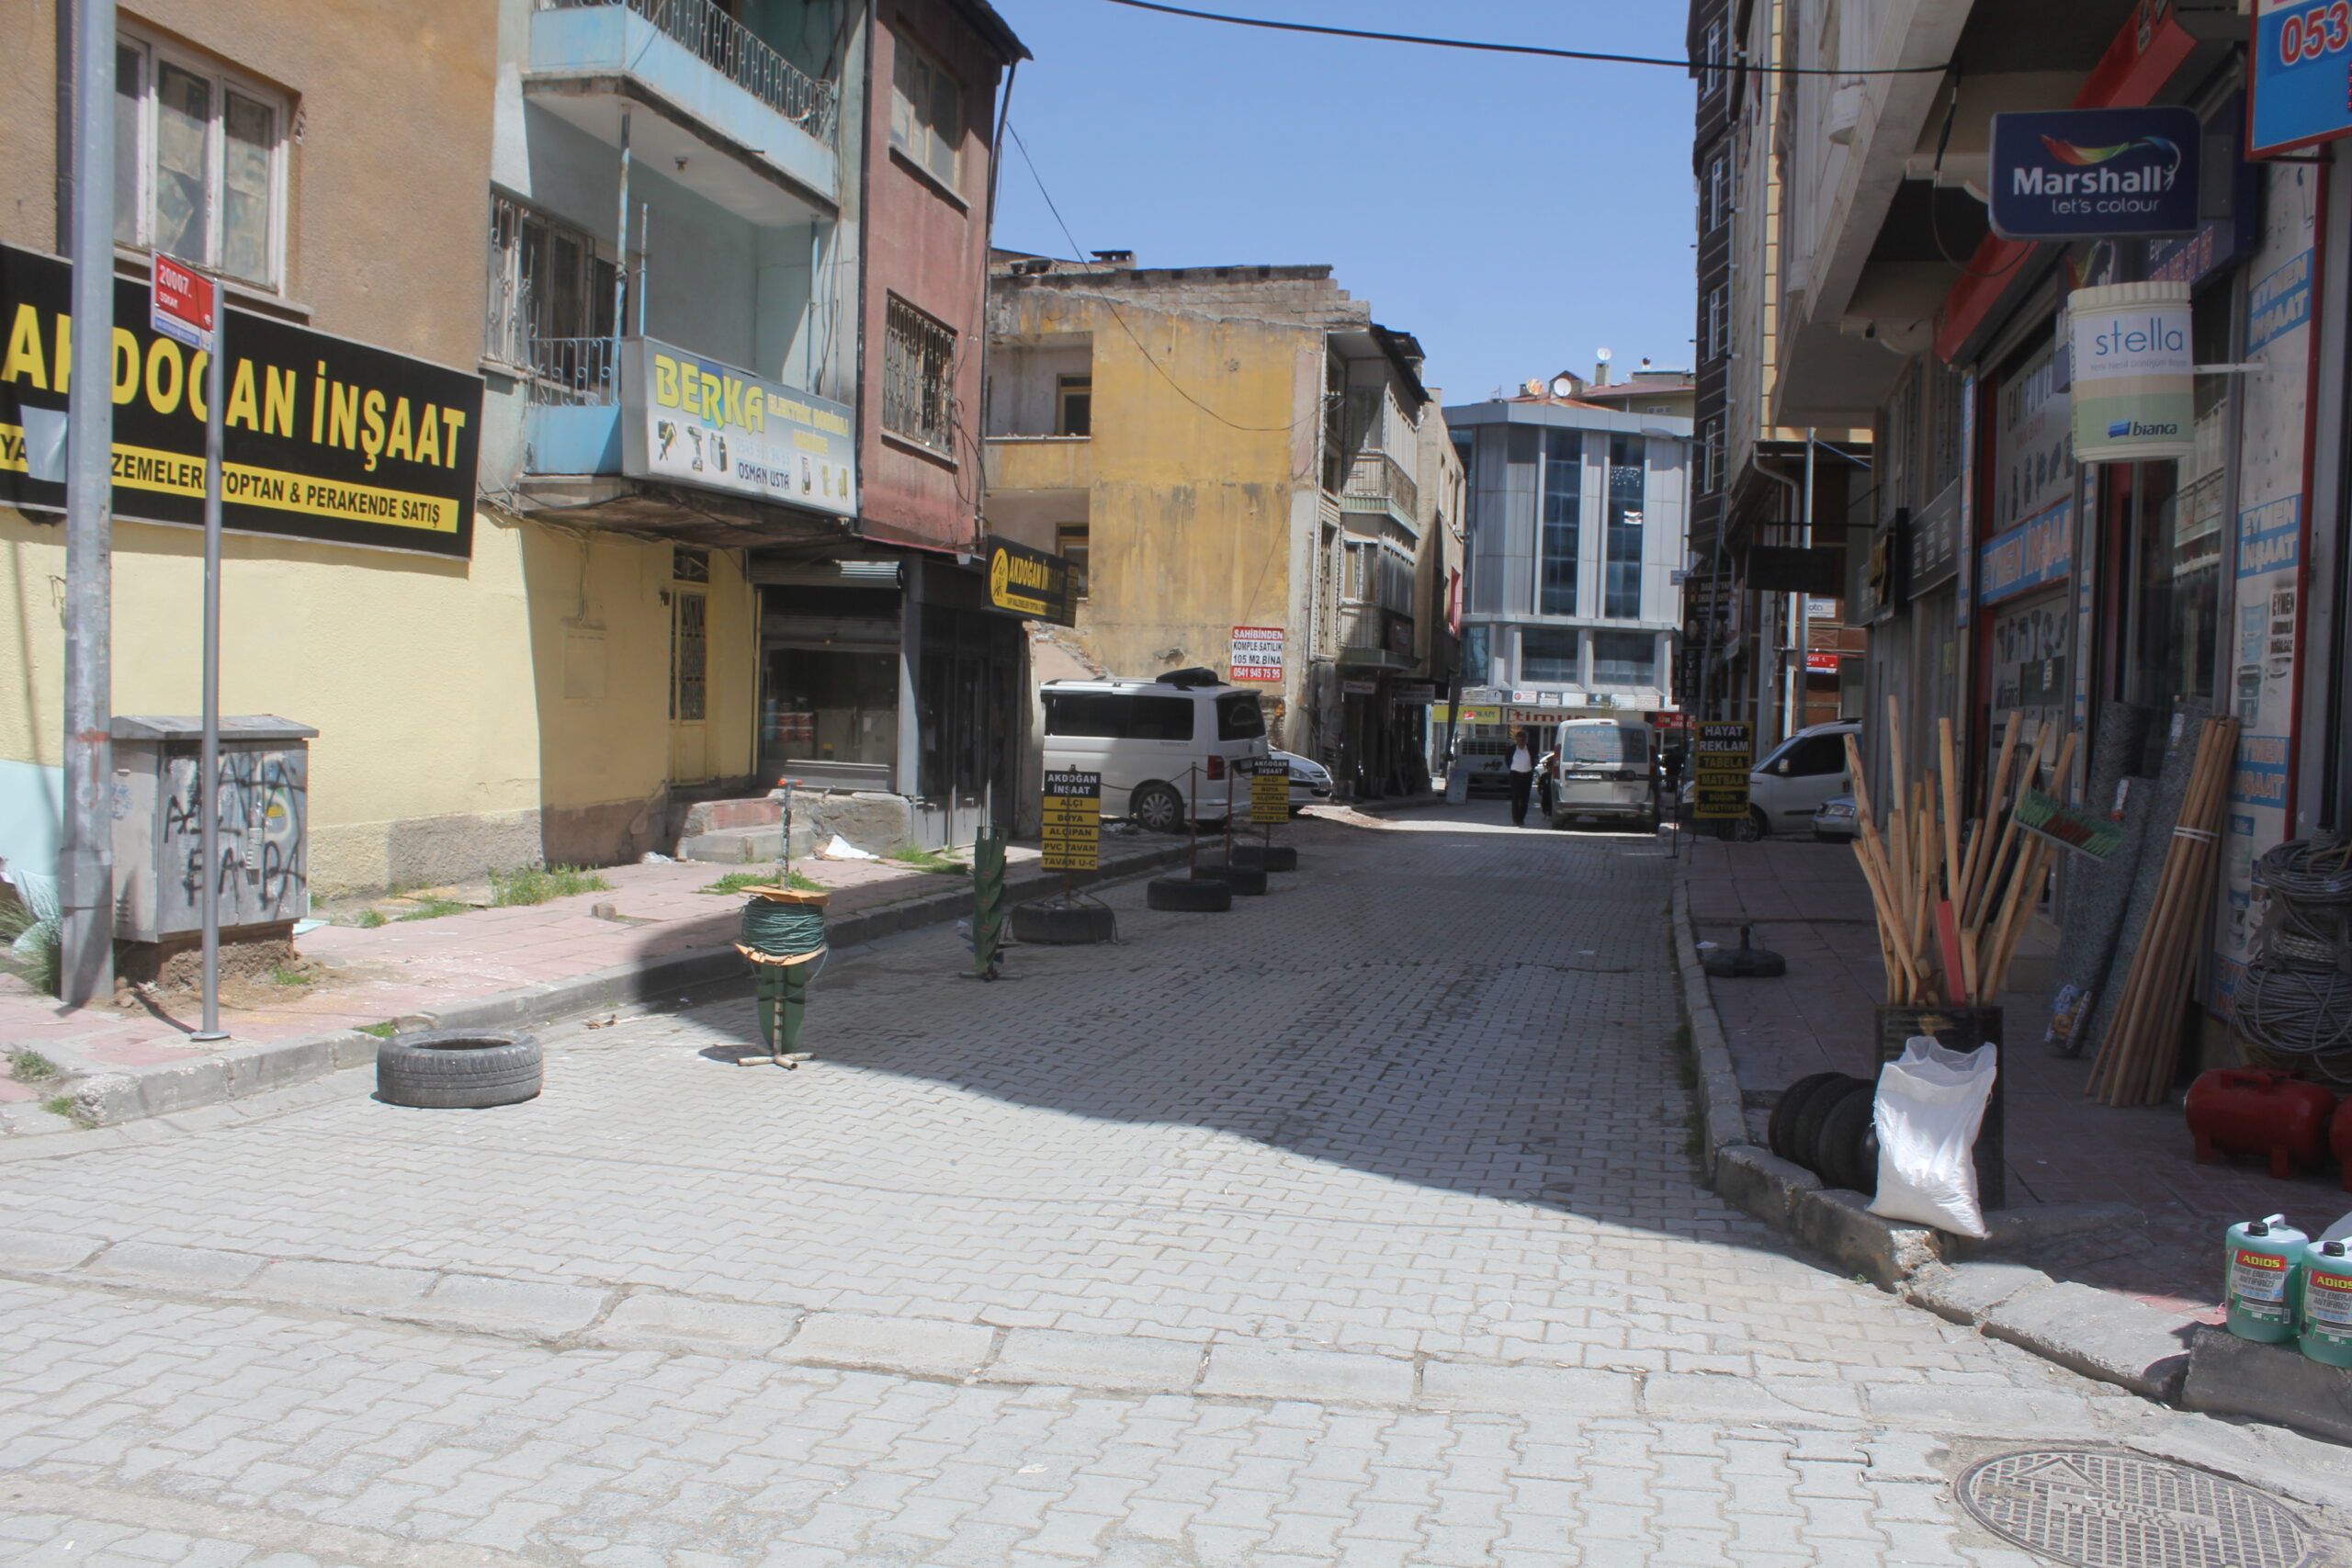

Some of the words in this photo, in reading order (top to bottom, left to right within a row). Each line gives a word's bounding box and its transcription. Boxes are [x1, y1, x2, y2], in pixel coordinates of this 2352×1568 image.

[2013, 165, 2162, 196] Marshall
[2052, 197, 2092, 214] let's
[2096, 197, 2160, 213] colour
[2095, 317, 2184, 356] stella
[654, 354, 764, 434] BERKA
[312, 360, 466, 472] İNŞAAT
[2132, 421, 2177, 437] bianca
[738, 462, 768, 486] OSMAN
[770, 469, 790, 491] USTA
[222, 471, 285, 502] OPTAN
[289, 481, 301, 503] &
[306, 484, 398, 518] PERAKENDE
[401, 499, 441, 529] SATIŞ
[2242, 496, 2297, 538] EYMEN
[2025, 508, 2071, 581] İNŞAA
[2240, 533, 2297, 573] İNŞAAT
[1234, 629, 1283, 640] SAHİBİNDEN
[1233, 641, 1258, 651] KOMPLE
[1260, 641, 1283, 652] SATILIK
[1233, 654, 1248, 664] 105
[1250, 655, 1261, 664] M2
[1262, 654, 1282, 666] BİNA
[1233, 667, 1249, 678] 0541
[1704, 726, 1744, 737] HAYAT
[1699, 740, 1749, 751] REKLAM
[1703, 757, 1744, 768] TABELA
[1047, 773, 1097, 784] AKDOĞAN
[1054, 784, 1091, 795] İNŞAAT
[1060, 798, 1083, 808] ALÇI
[1057, 814, 1084, 823] BOYA
[1049, 828, 1092, 837] ALÇIPAN
[1044, 842, 1063, 852] PVC
[1066, 842, 1096, 852] TAVAN
[1044, 857, 1076, 866] TAVAN
[2062, 1500, 2206, 1533] TELEKOM
